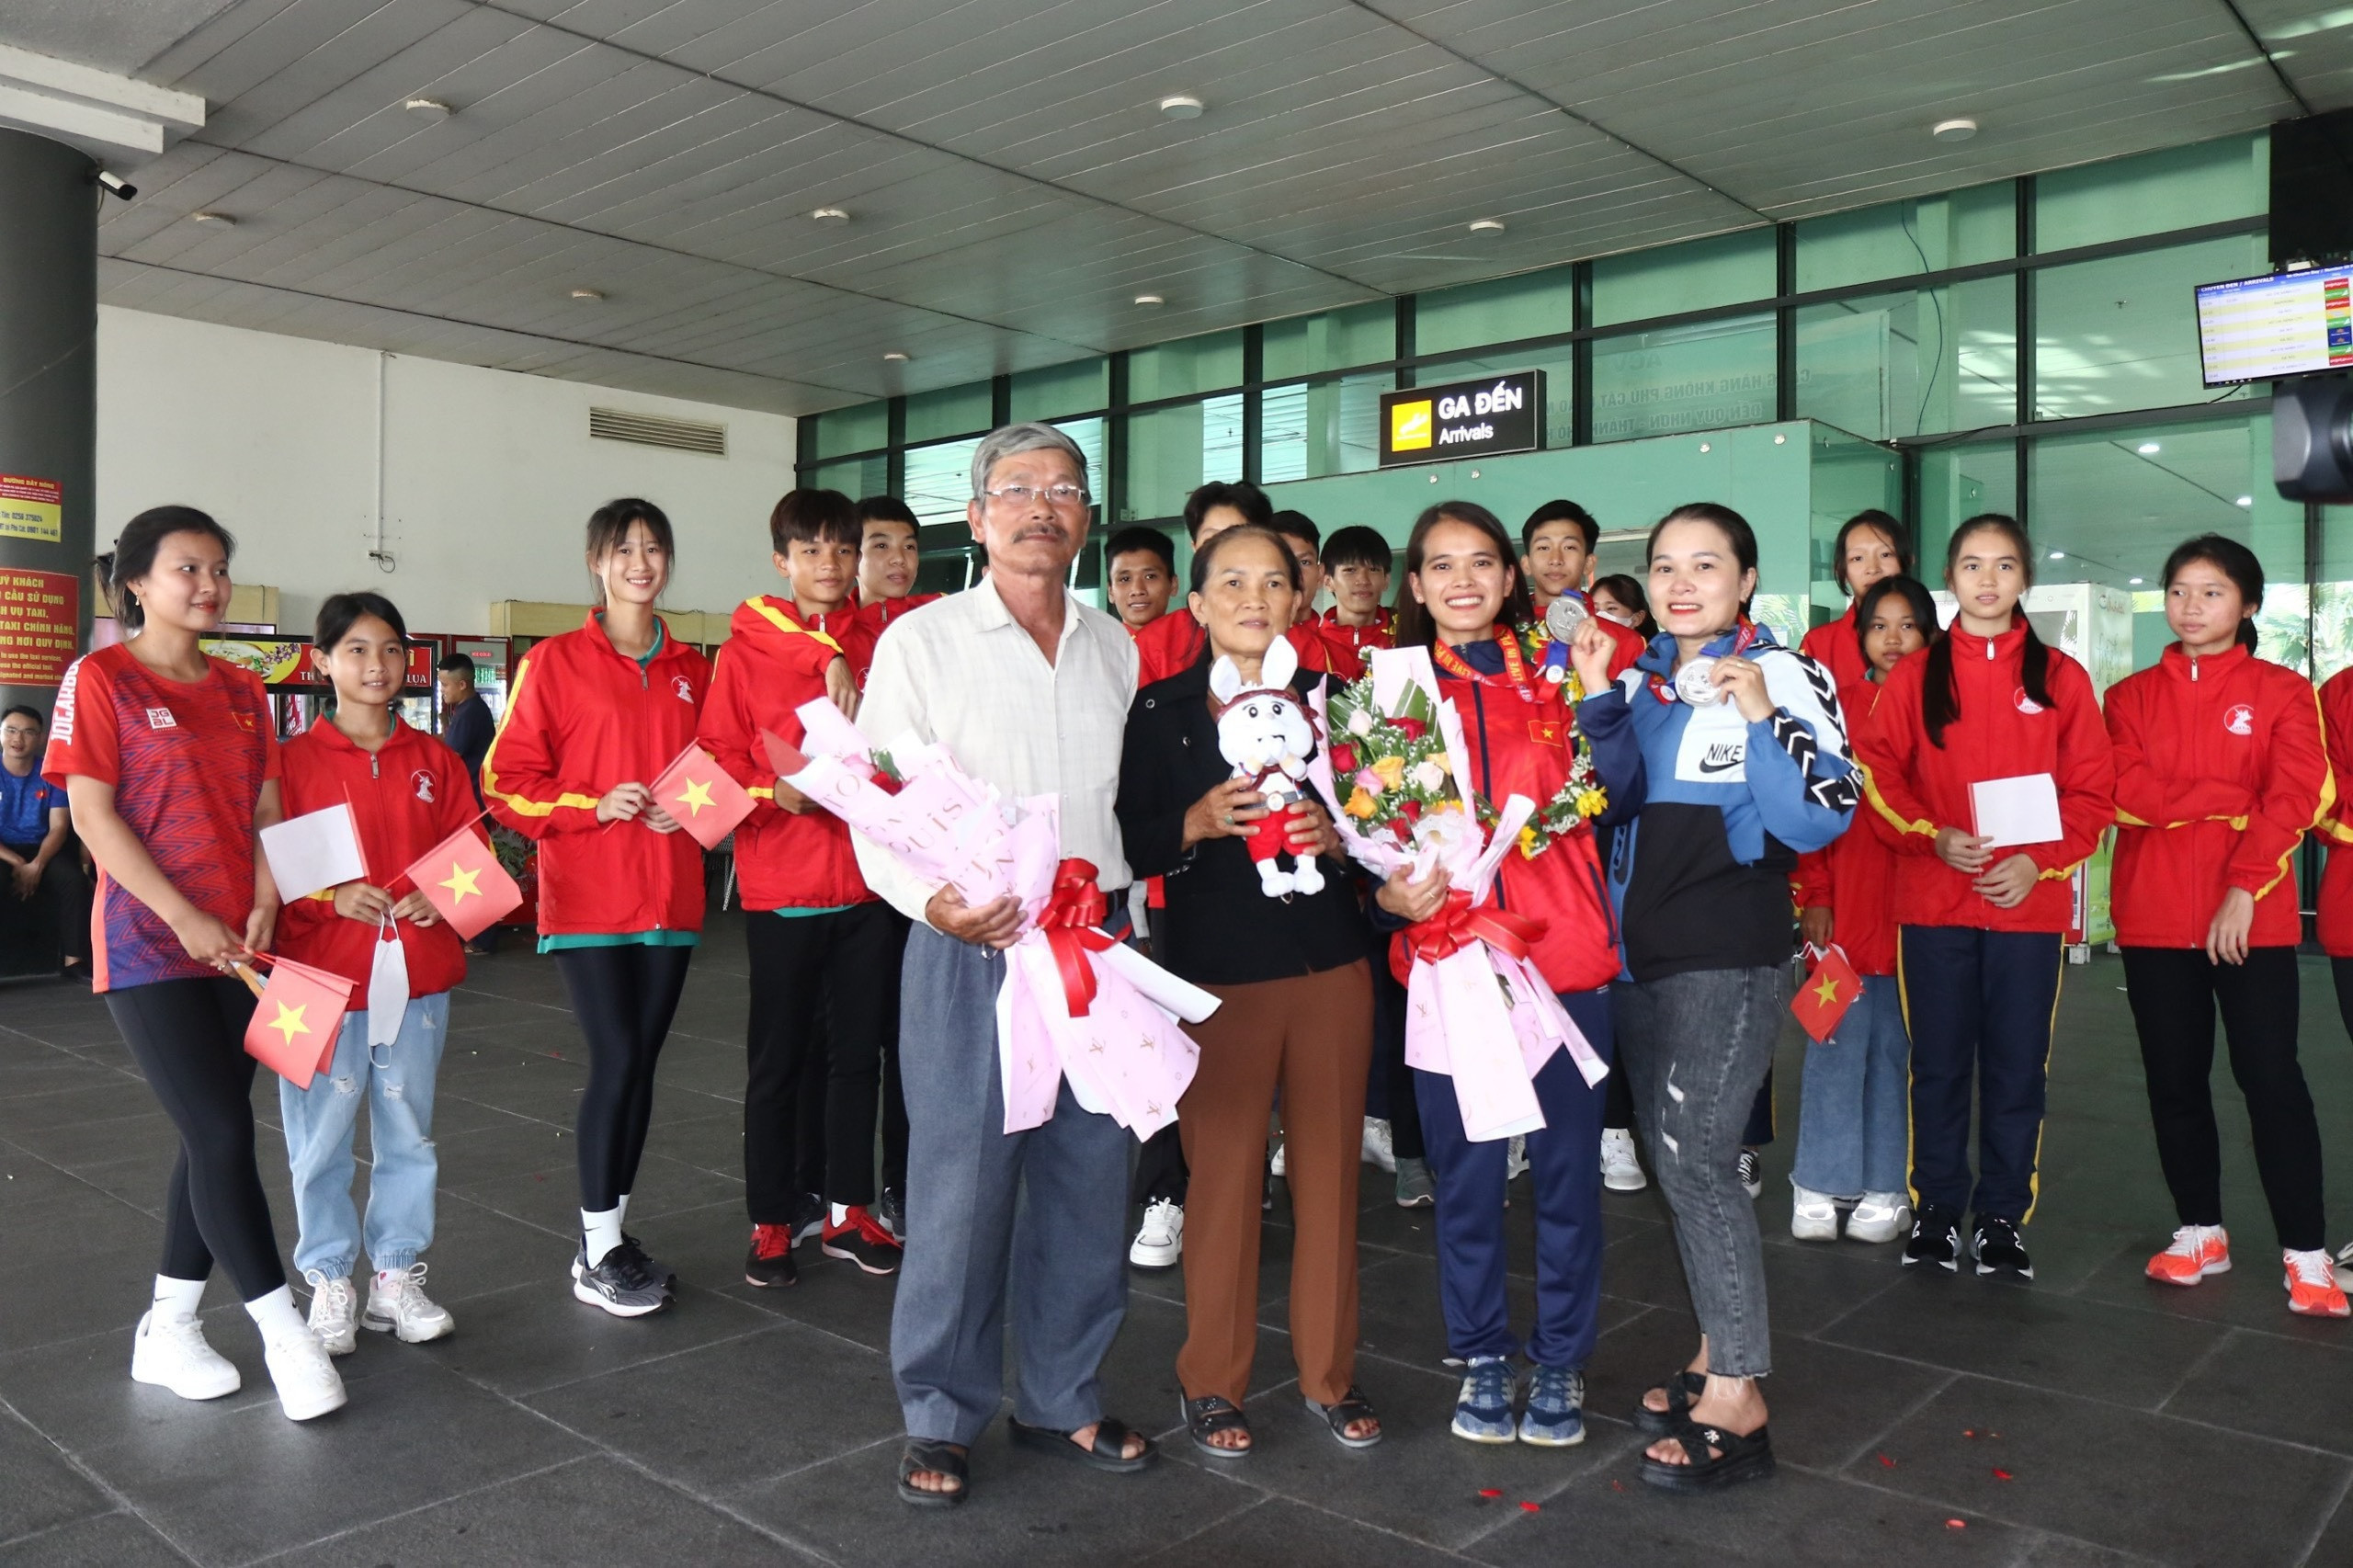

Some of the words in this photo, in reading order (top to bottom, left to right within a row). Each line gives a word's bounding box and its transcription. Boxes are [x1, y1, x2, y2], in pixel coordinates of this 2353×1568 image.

[1438, 395, 1471, 419] GA
[1474, 381, 1522, 415] ĐẾN
[1438, 422, 1494, 445] Arrivals
[13, 576, 44, 588] KHÁCH
[27, 608, 49, 619] TAXI.
[0, 620, 20, 631] TAXI
[36, 637, 52, 648] QUY
[1706, 743, 1743, 763] NIKE
